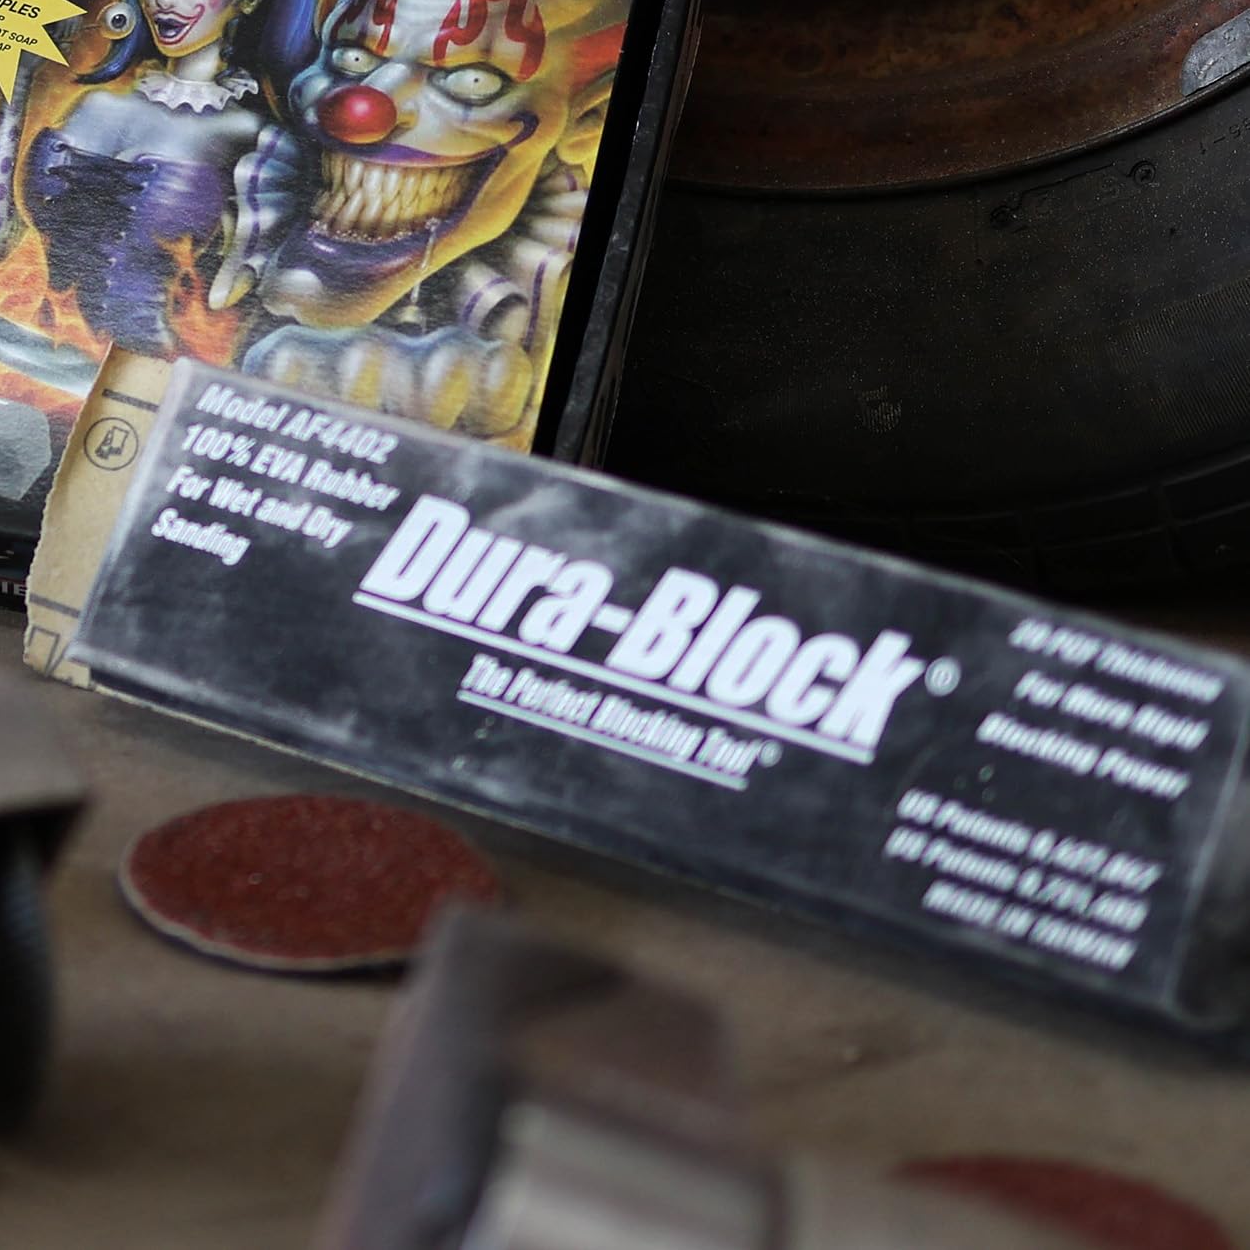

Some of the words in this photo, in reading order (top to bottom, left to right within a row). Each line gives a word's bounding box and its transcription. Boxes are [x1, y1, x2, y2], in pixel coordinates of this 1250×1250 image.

[8, 32, 38, 47] SOAP
[196, 382, 291, 432] Model
[280, 409, 399, 465] AF4402
[166, 464, 213, 501] For
[208, 476, 263, 517] Wet
[254, 497, 313, 532] and
[301, 505, 353, 549] Dry
[181, 423, 258, 468] 100%
[250, 443, 308, 485] EVA
[301, 458, 400, 511] Rubber
[151, 507, 251, 566] Sanding
